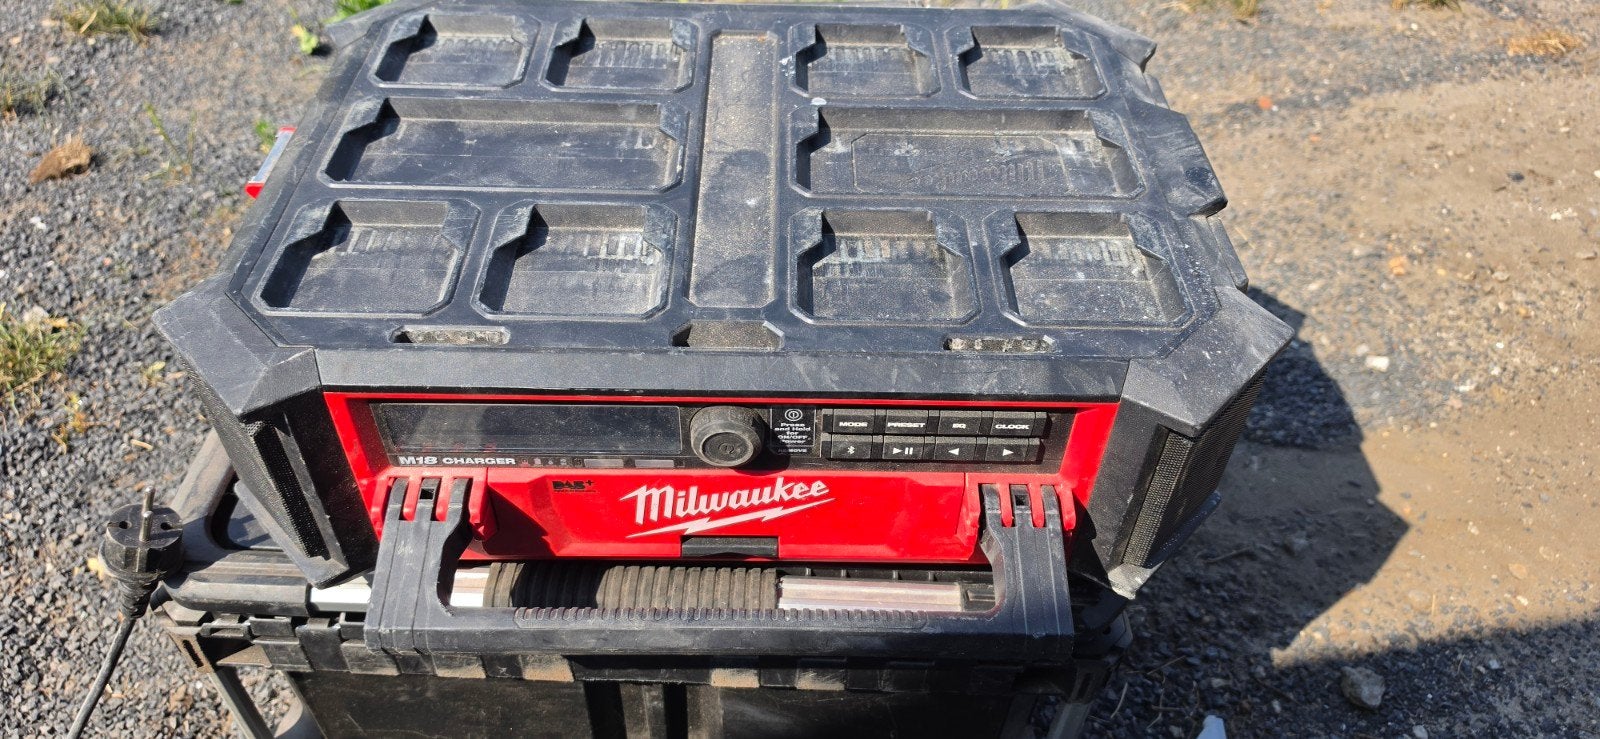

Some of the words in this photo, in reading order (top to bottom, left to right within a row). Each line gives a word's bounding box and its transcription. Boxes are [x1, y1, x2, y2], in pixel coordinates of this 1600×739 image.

[399, 456, 438, 465] M18
[442, 457, 516, 465] CHARGER
[619, 476, 830, 526] Milwaukee
